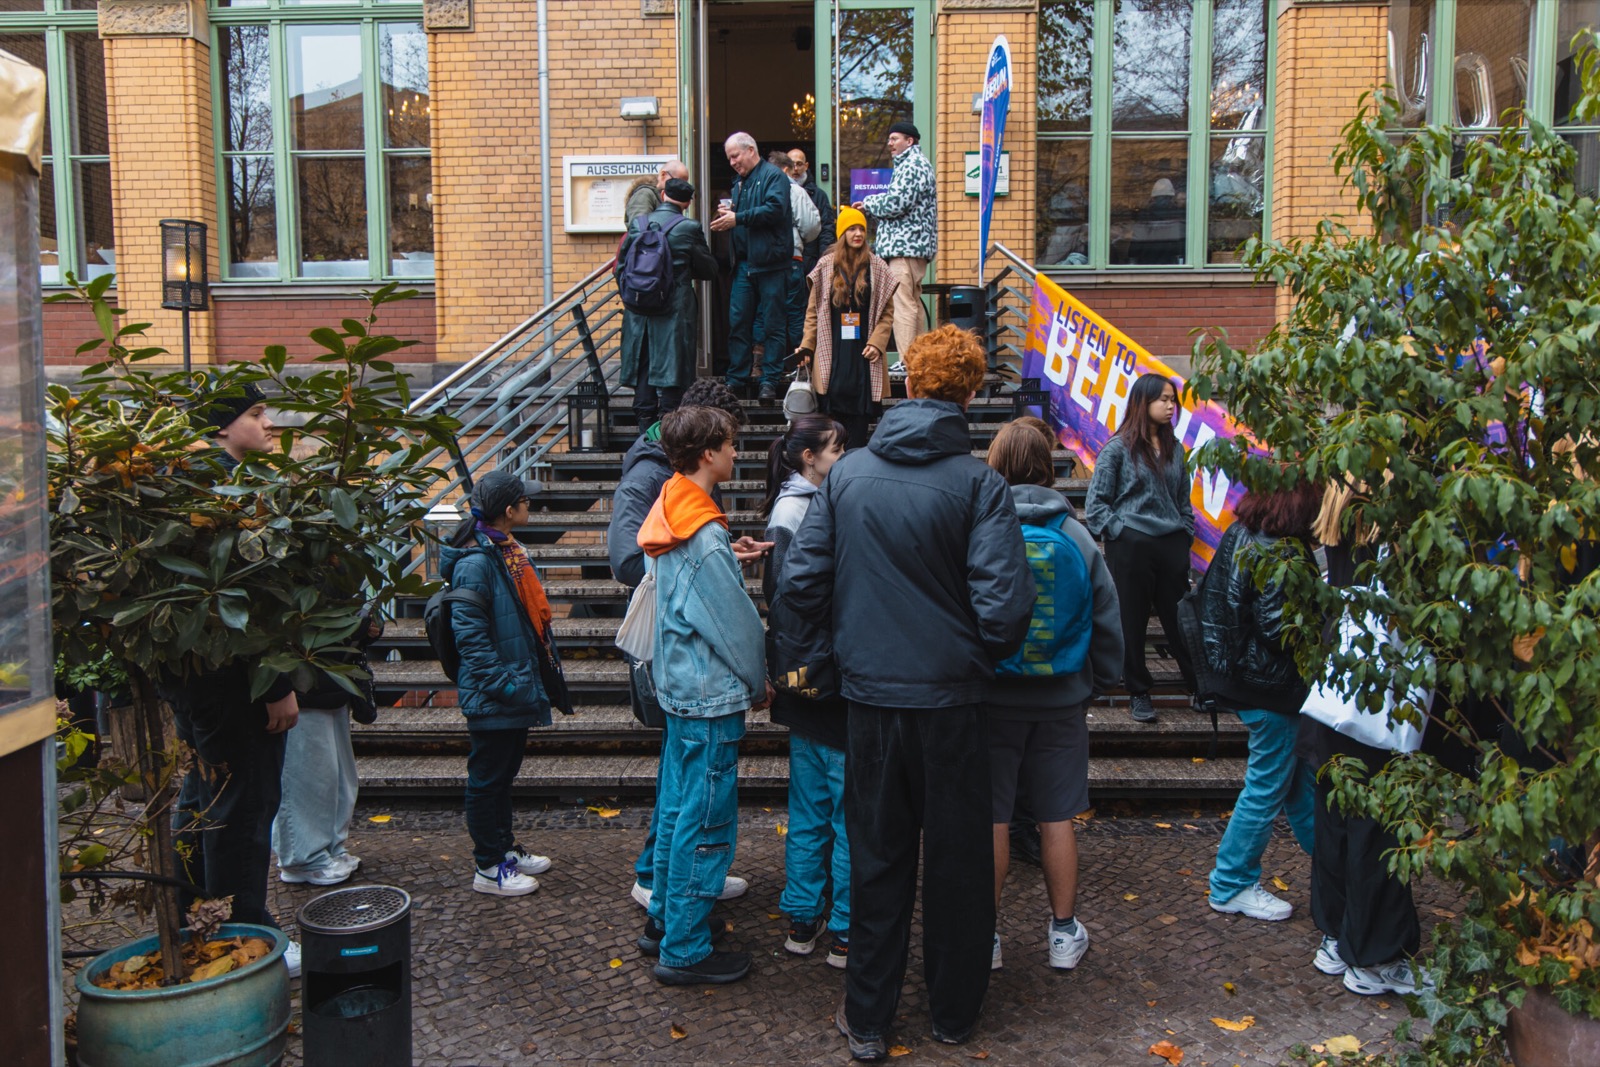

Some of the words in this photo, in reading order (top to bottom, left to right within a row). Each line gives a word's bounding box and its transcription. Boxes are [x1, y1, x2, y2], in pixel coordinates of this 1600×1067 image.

[586, 164, 659, 175] AUSSCHANK
[1056, 300, 1111, 357] LISTEN
[1115, 342, 1137, 376] TO
